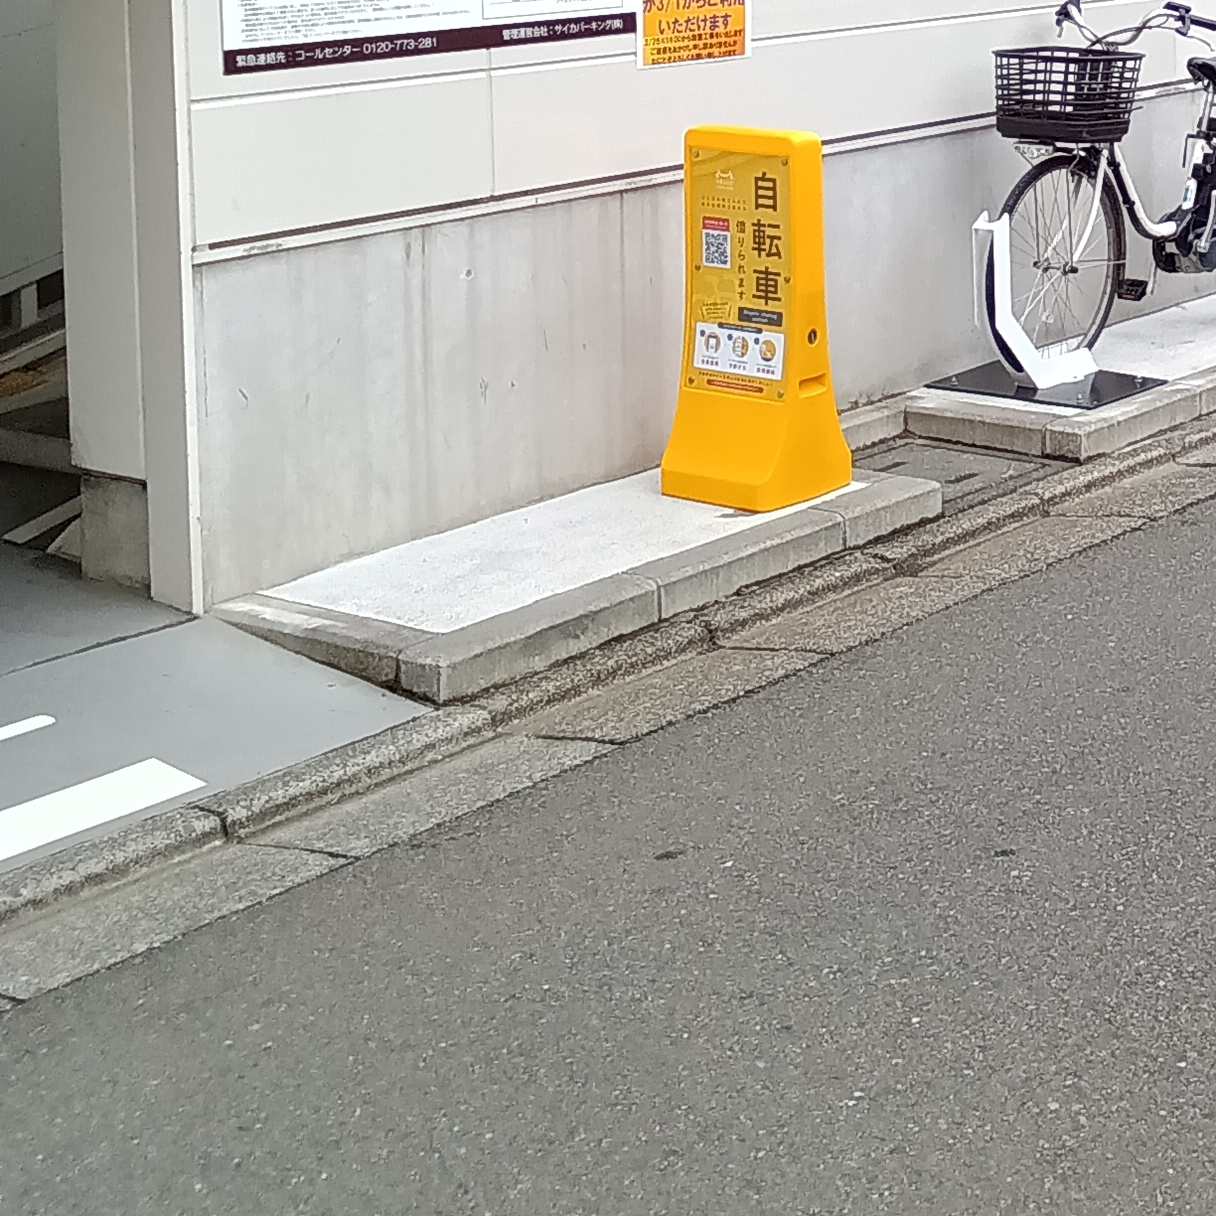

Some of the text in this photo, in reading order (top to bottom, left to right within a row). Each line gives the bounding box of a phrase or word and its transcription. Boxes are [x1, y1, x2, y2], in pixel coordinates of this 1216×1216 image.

[363, 37, 437, 54] 0120-773-281
[659, 13, 732, 35] いただけます
[736, 220, 746, 301] 借りられます
[752, 171, 782, 306] 自転車
